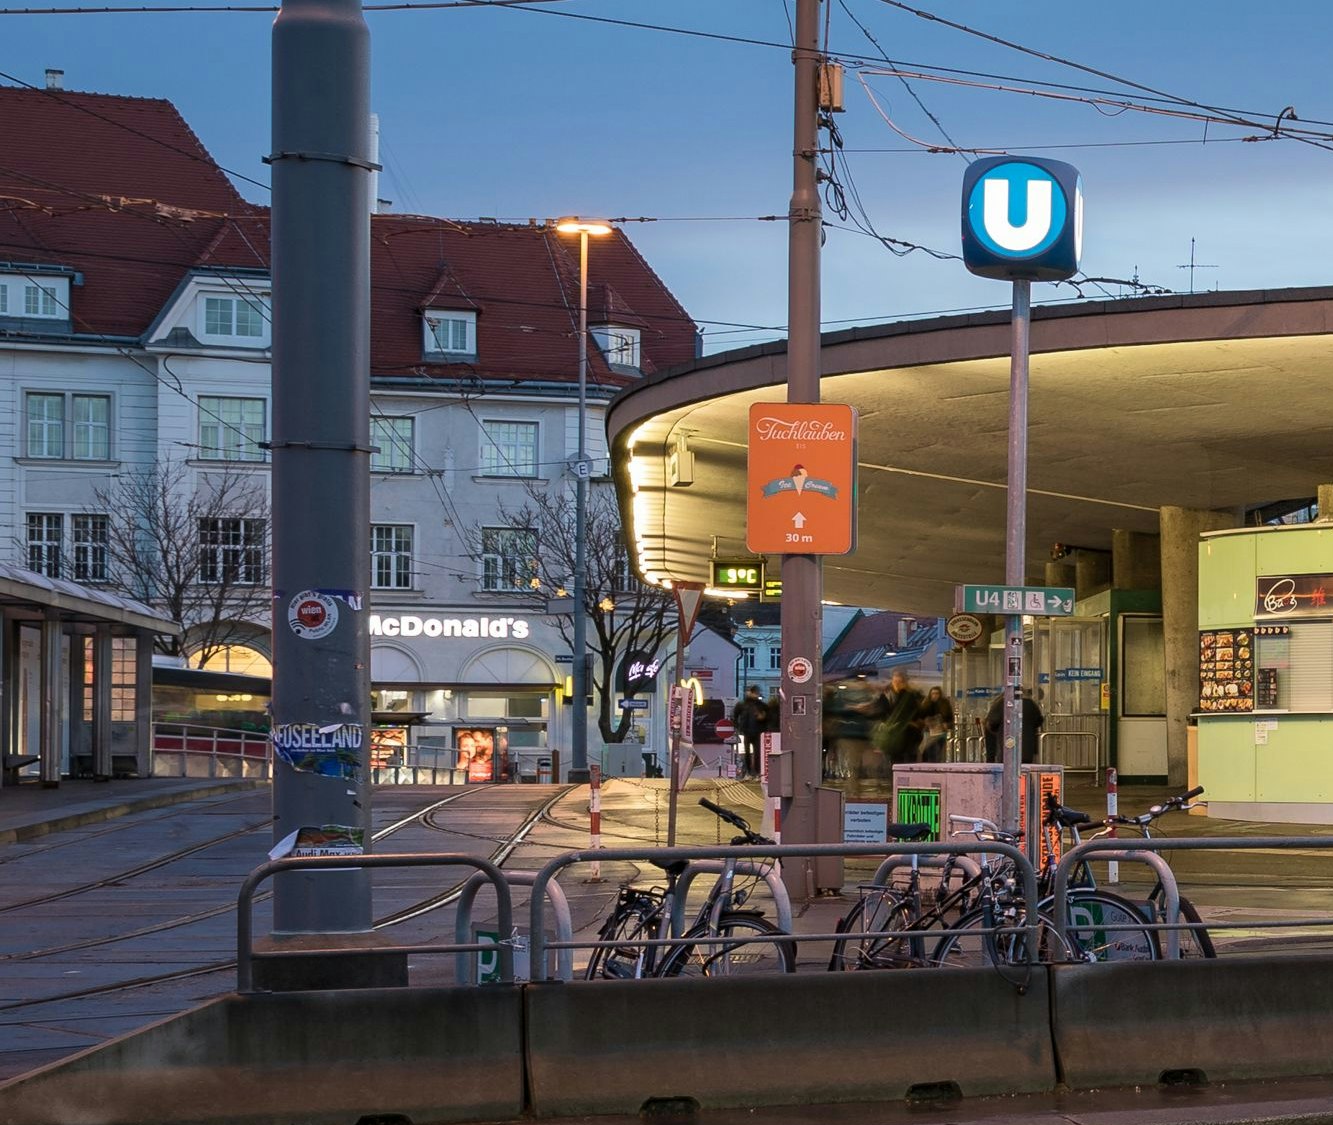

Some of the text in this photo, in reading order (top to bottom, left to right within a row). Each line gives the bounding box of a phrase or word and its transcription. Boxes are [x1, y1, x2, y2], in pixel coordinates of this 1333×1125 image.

[984, 178, 1052, 251] U
[757, 417, 845, 441] Tuchlauben
[580, 464, 587, 475] E
[785, 534, 799, 542] 30
[976, 590, 1000, 605] U4
[369, 615, 529, 639] McDonald's
